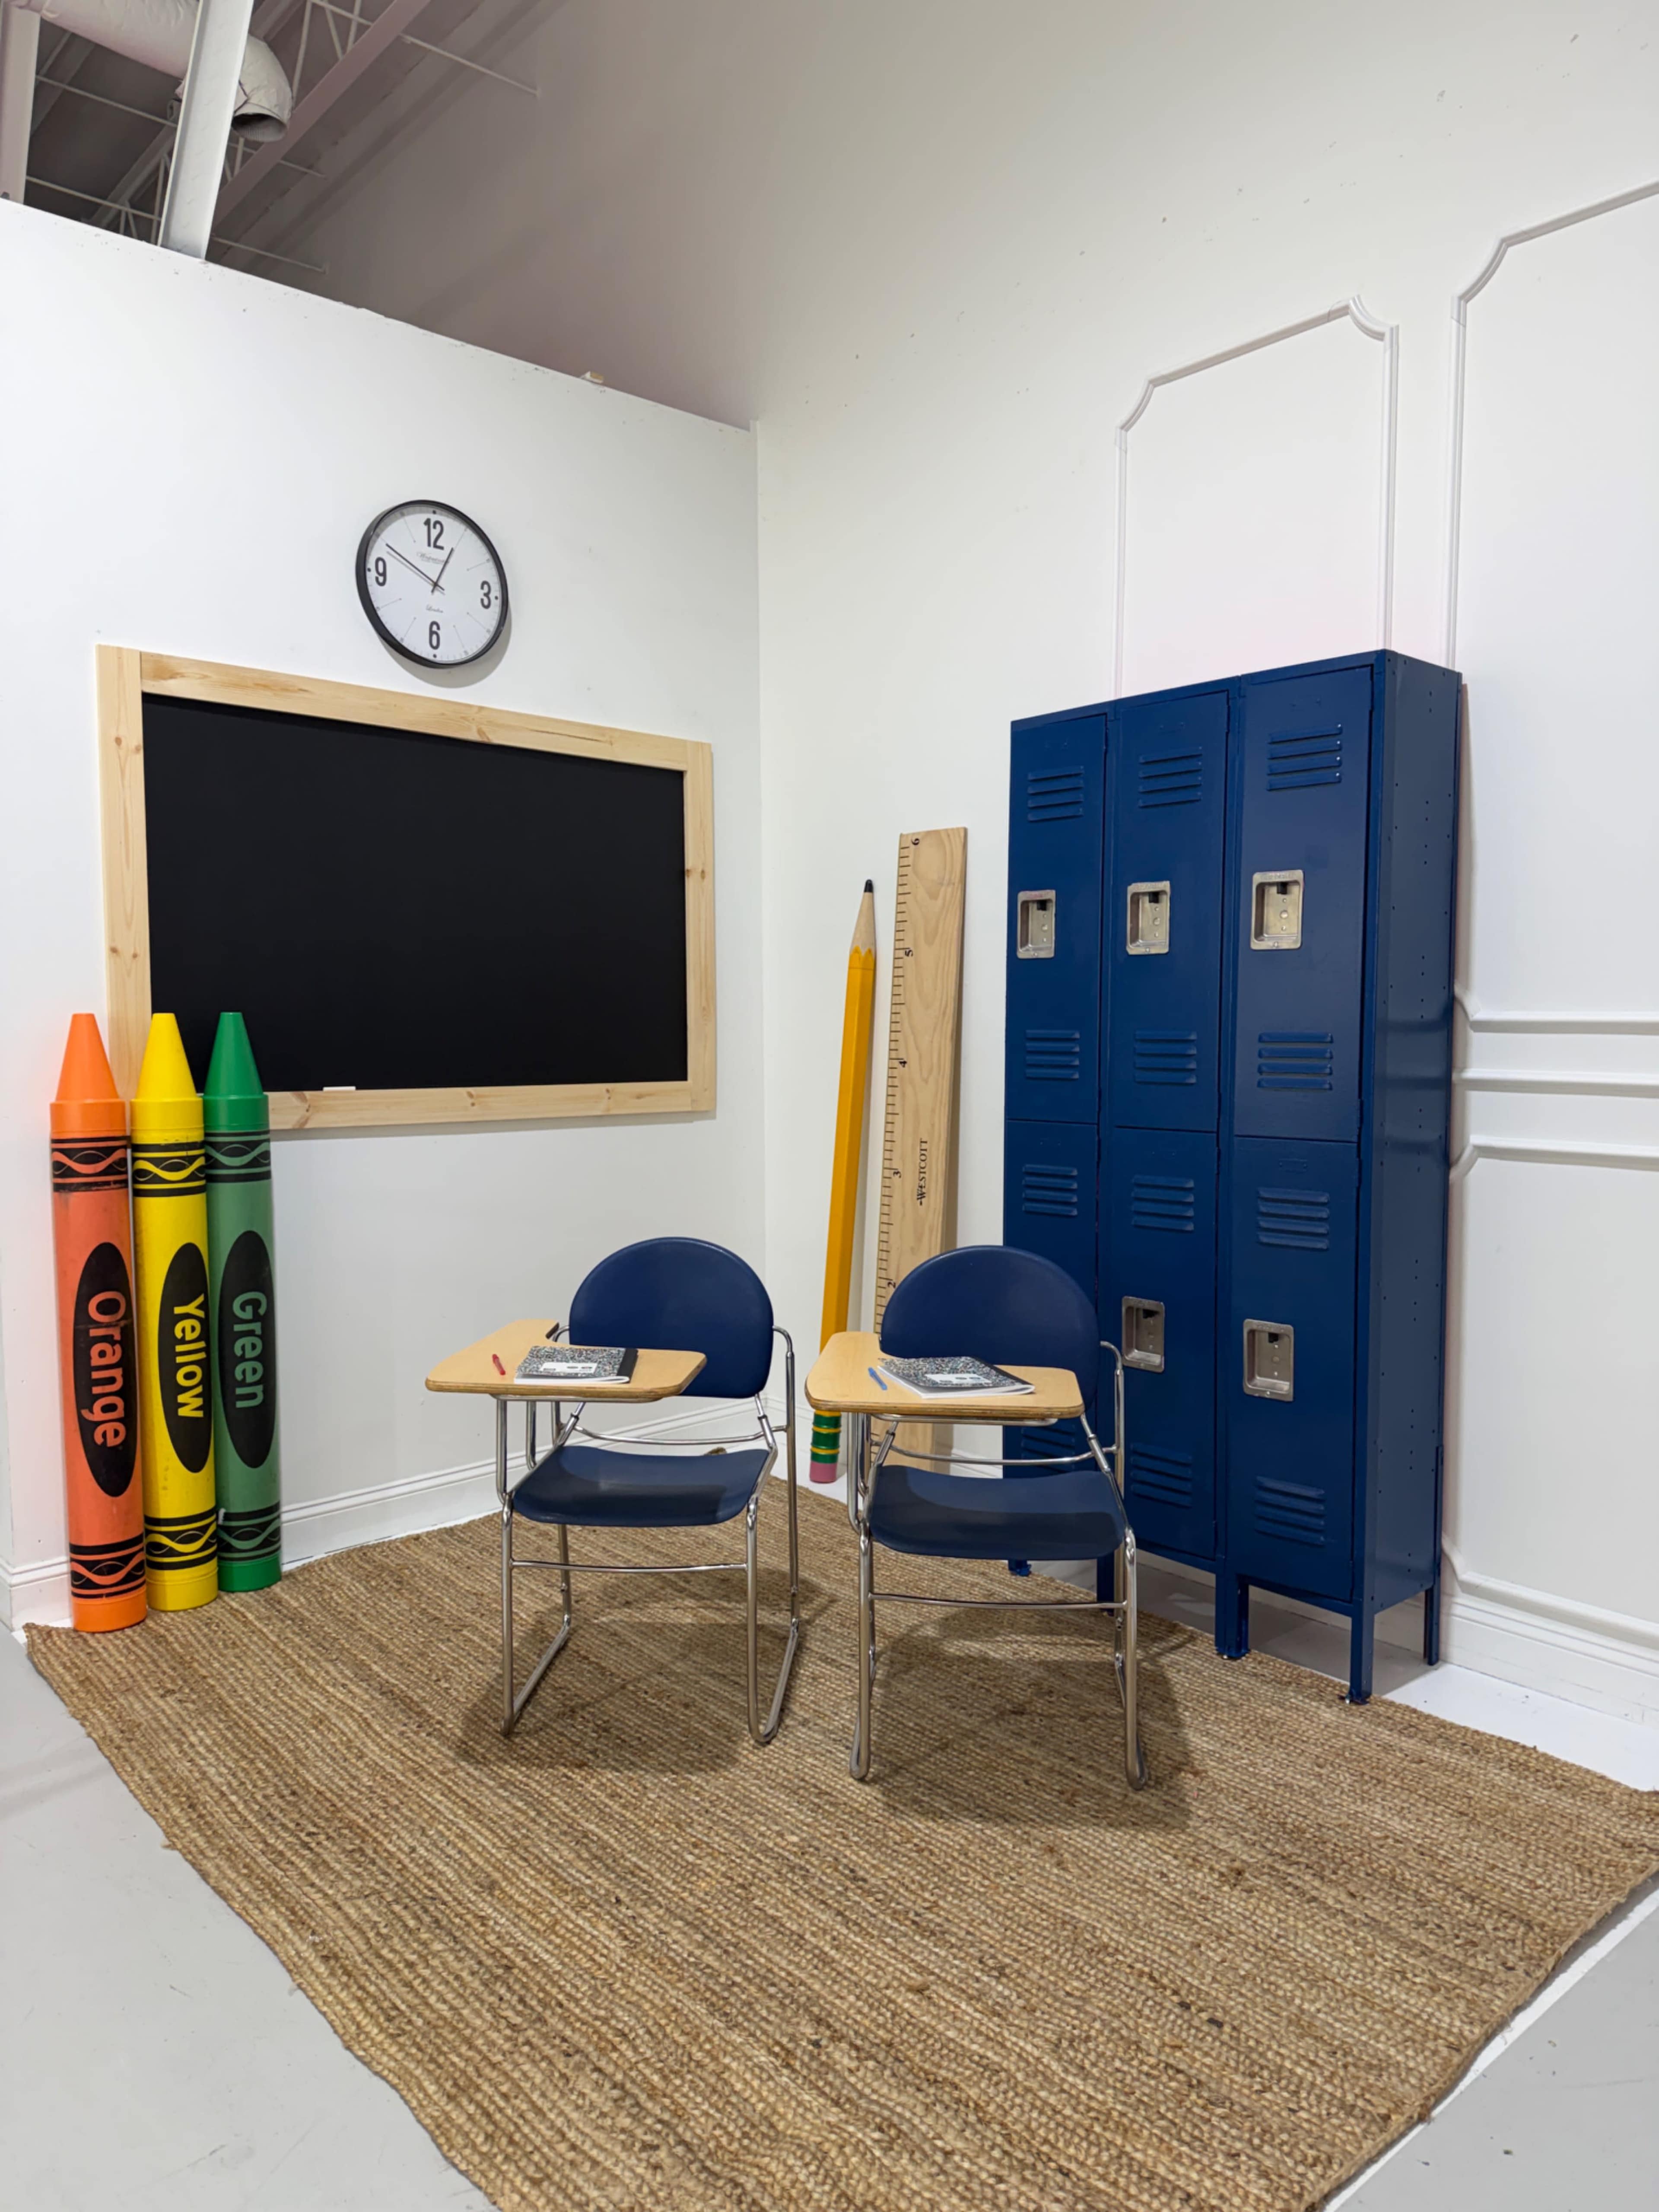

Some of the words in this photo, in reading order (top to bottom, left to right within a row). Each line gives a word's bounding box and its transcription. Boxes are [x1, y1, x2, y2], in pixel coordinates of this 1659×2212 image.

[423, 518, 444, 550] 12
[375, 557, 387, 587] 9
[480, 580, 492, 610] 3
[429, 621, 440, 650] 6
[904, 949, 913, 957] 5
[899, 1060, 908, 1068] 4
[893, 1170, 902, 1179] 3
[916, 1137, 928, 1205] WESTCOTT
[887, 1281, 896, 1289] 2
[173, 1293, 207, 1418] Yellow
[232, 1290, 267, 1409] Green
[81, 1290, 127, 1447] Orange
